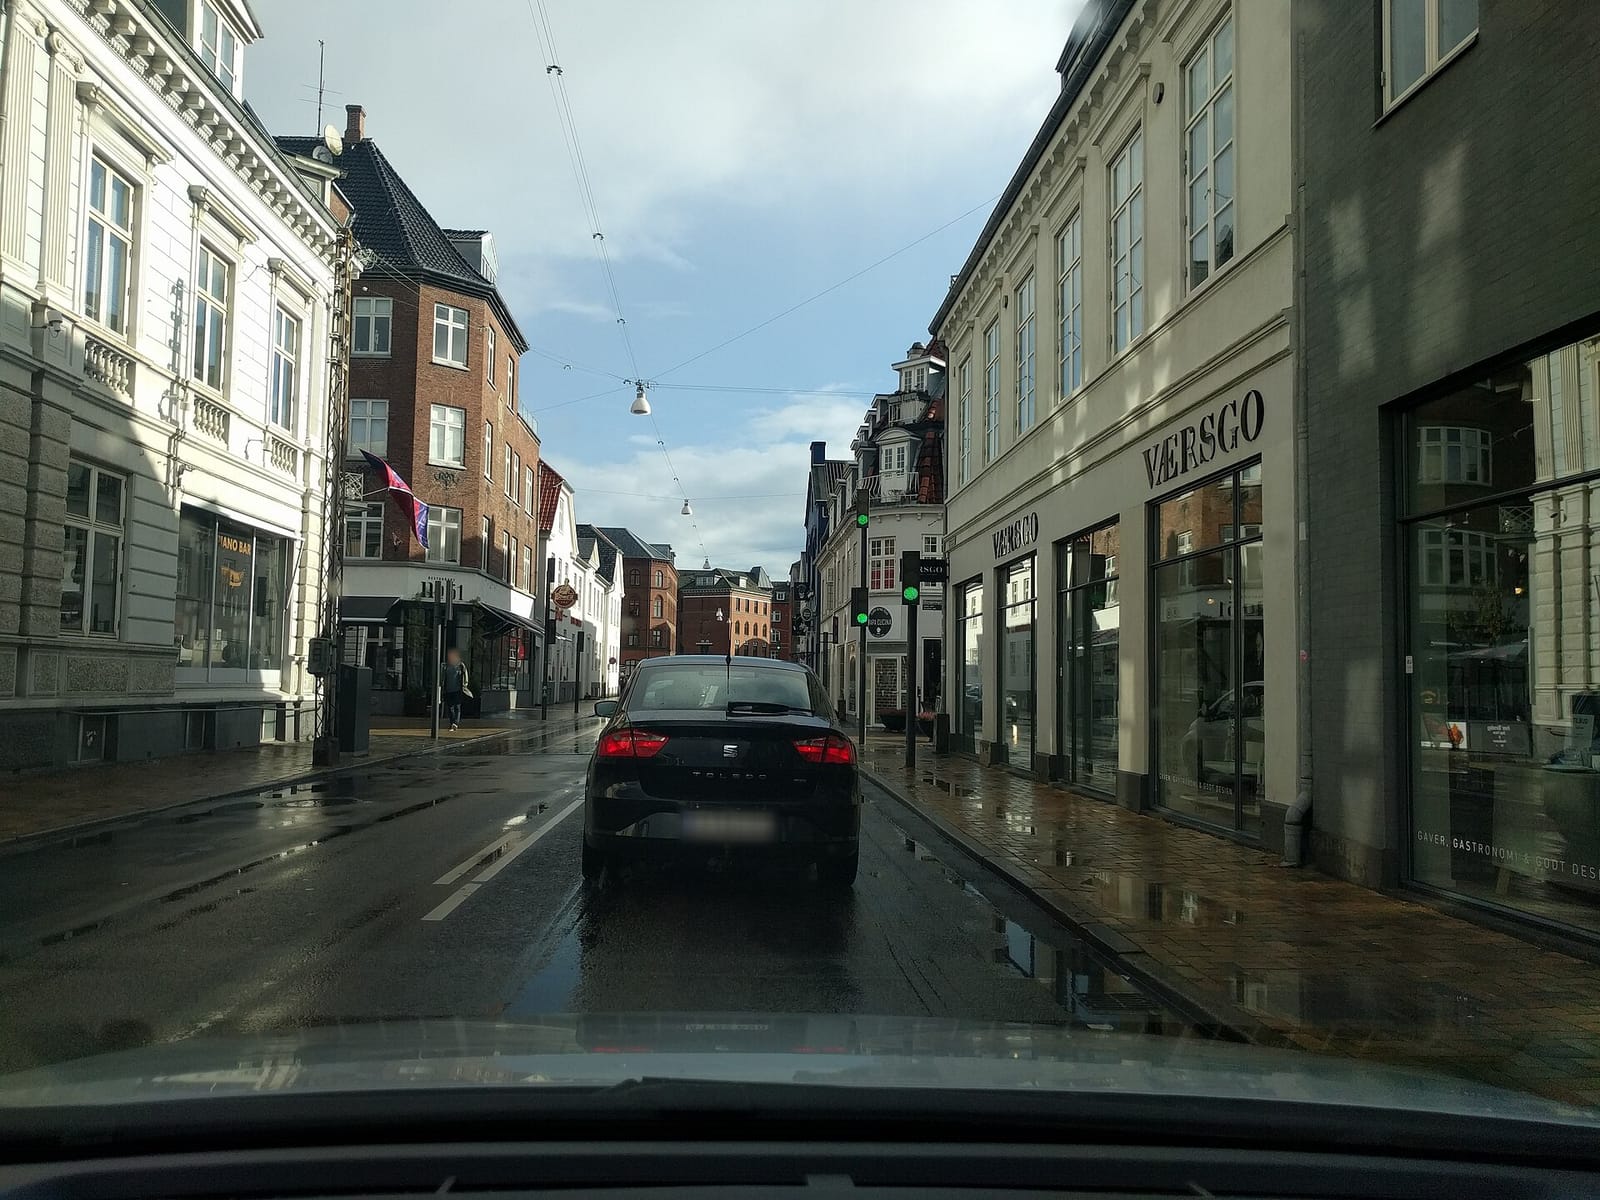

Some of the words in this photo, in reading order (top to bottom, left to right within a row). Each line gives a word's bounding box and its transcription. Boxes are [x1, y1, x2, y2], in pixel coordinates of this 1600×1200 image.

[1142, 390, 1264, 489] VÆRSGO
[239, 541, 251, 555] BAR
[992, 512, 1039, 559] VÆRSGO
[1452, 838, 1518, 861] GASTRONOMI
